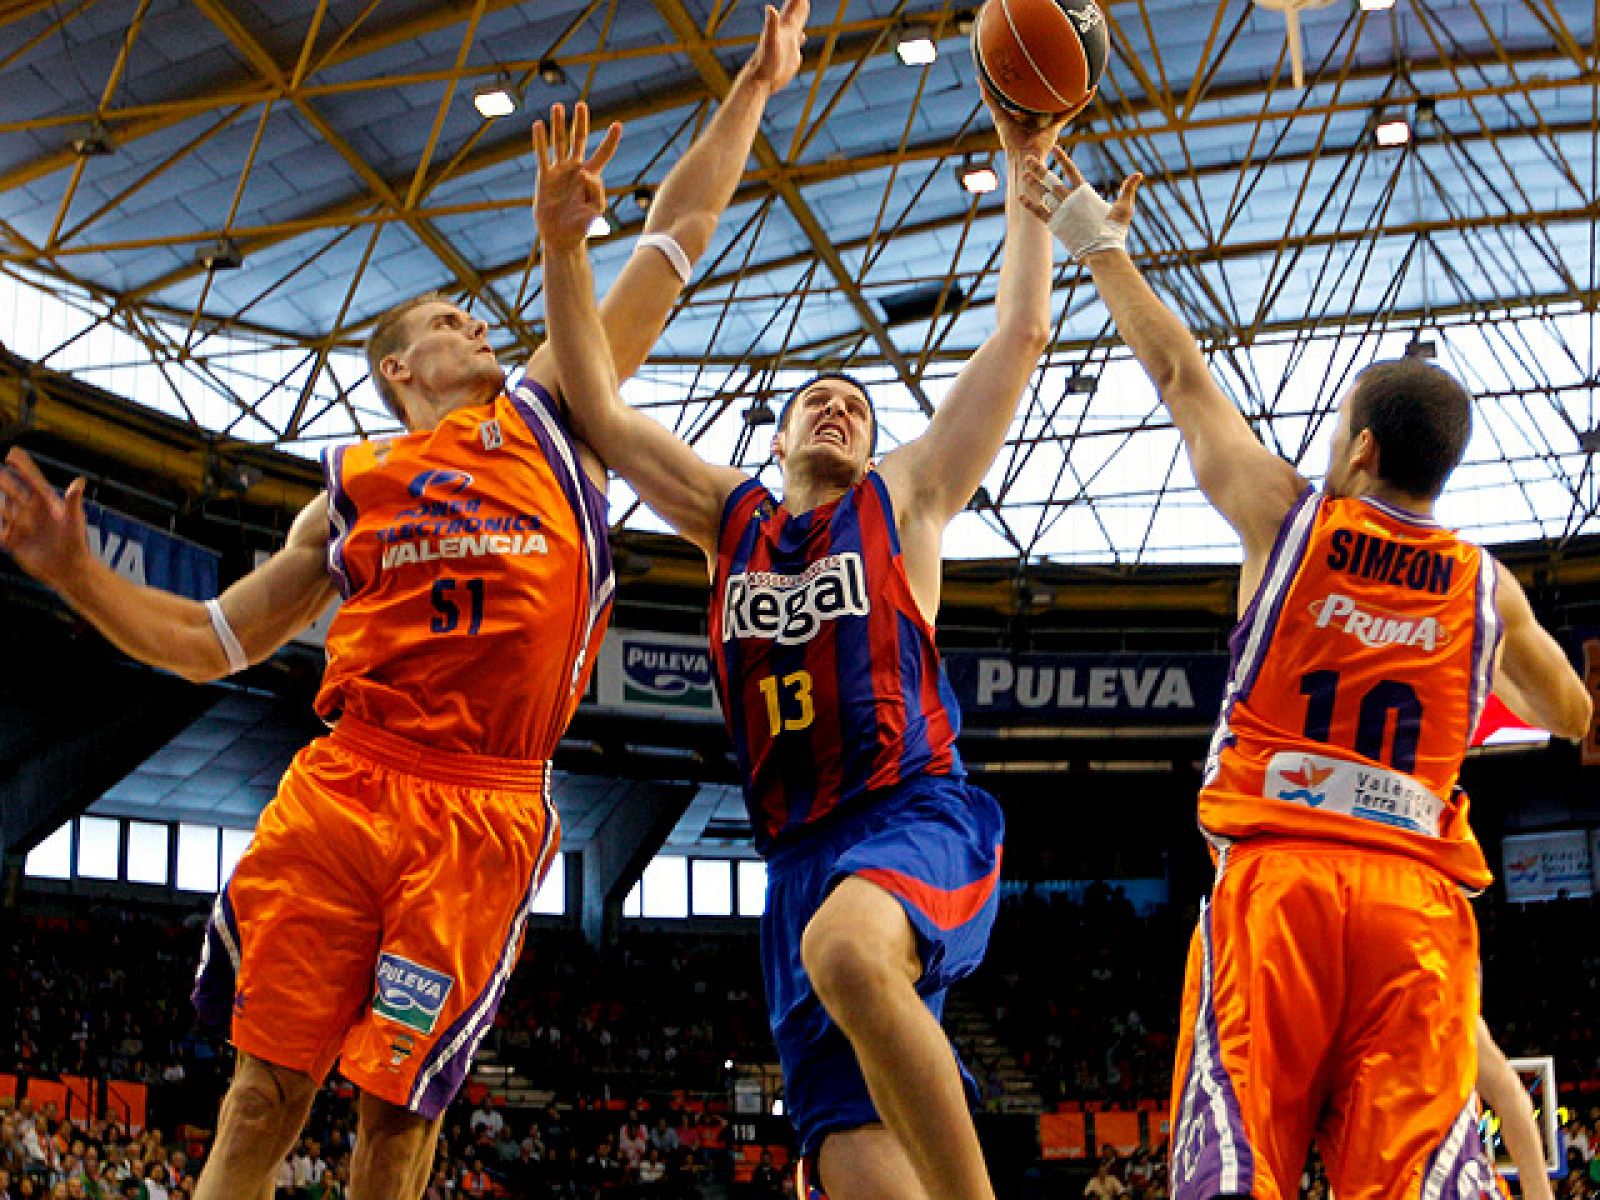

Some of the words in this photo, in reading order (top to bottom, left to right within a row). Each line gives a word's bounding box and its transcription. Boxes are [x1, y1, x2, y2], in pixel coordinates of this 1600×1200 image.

[381, 533, 549, 571] VALENCIA
[1326, 529, 1455, 595] SIMEON
[723, 554, 868, 643] Regal
[627, 646, 708, 673] PULEVA
[976, 658, 1196, 709] PULEVA
[759, 669, 816, 738] 13
[1299, 668, 1423, 775] 10
[380, 961, 441, 999] PULEVA
